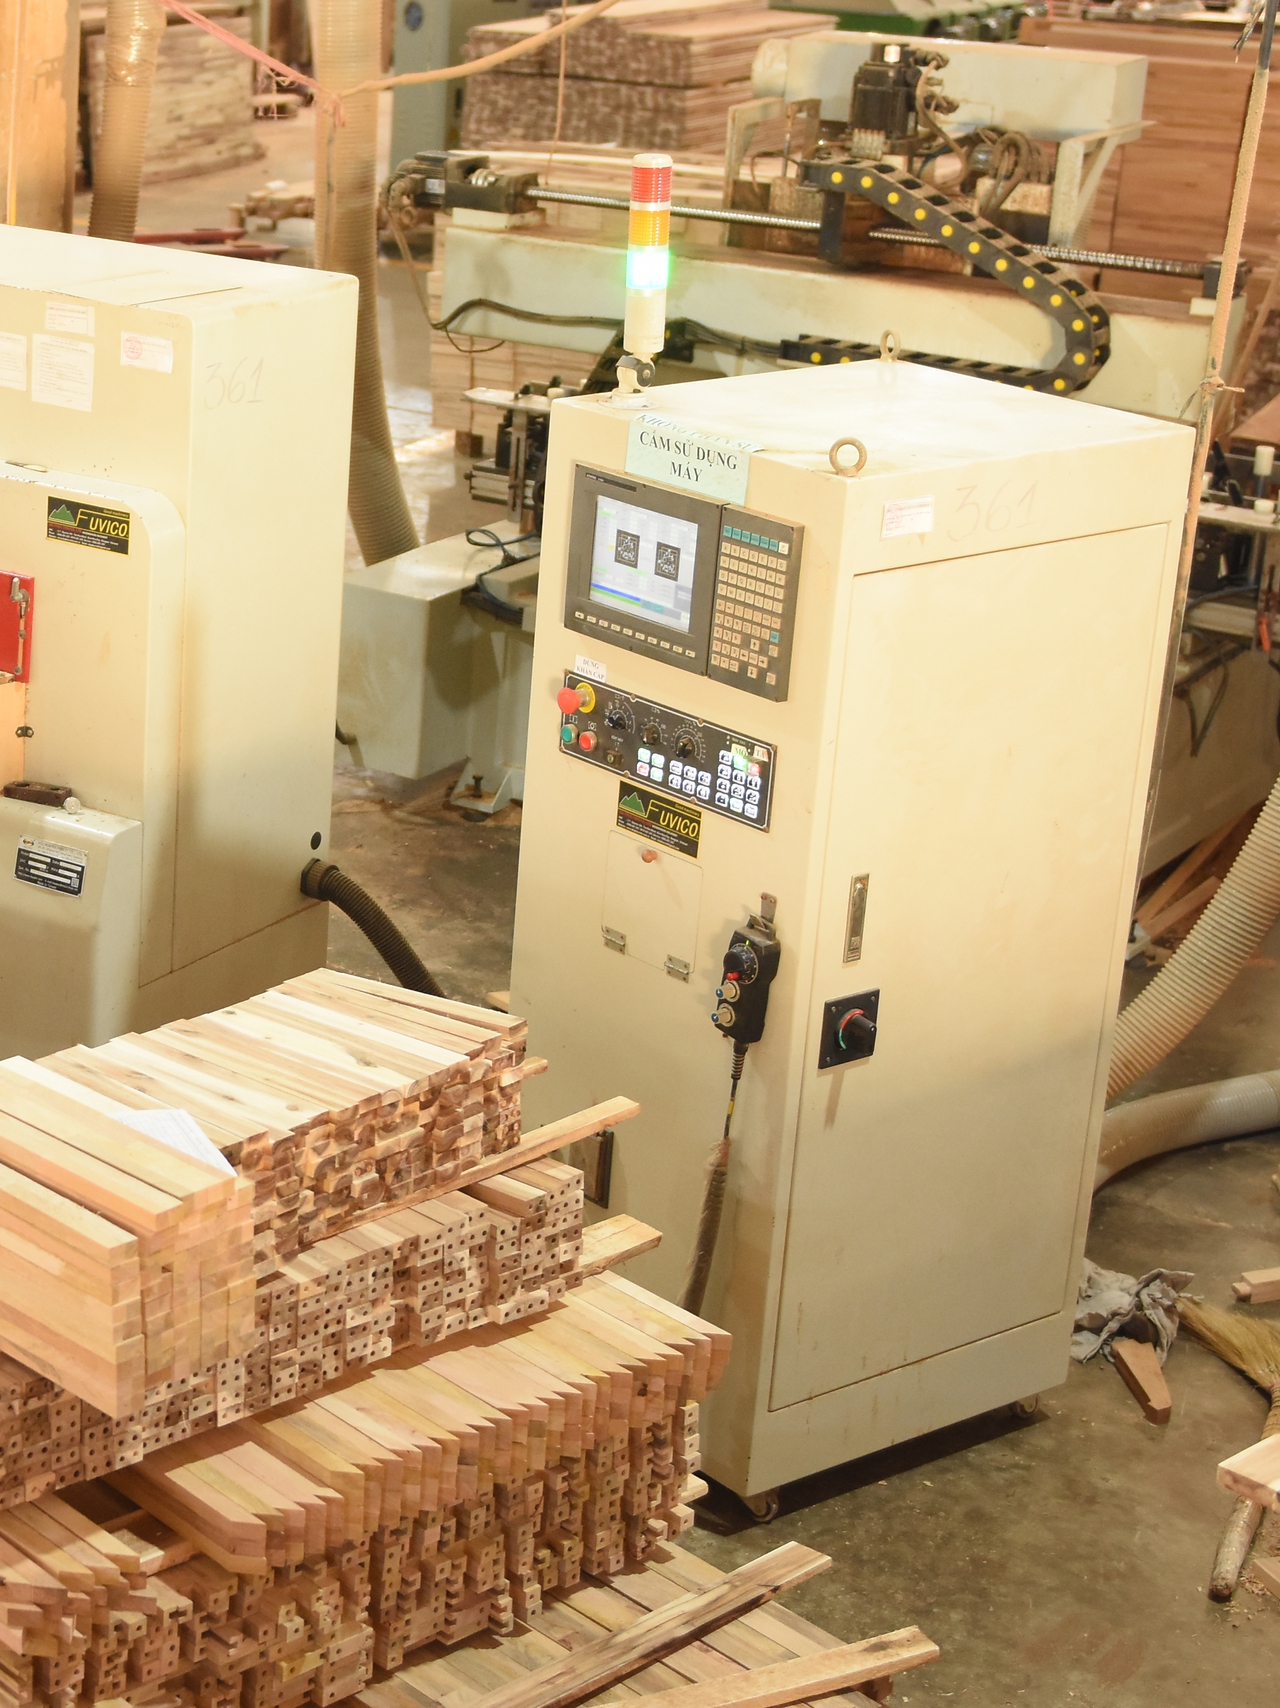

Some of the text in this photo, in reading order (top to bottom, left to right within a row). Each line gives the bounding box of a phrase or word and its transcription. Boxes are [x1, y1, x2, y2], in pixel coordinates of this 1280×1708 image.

[204, 356, 264, 410] 361
[669, 461, 703, 482] MÁY
[696, 446, 738, 470] DỤNG
[946, 479, 1039, 542] 361
